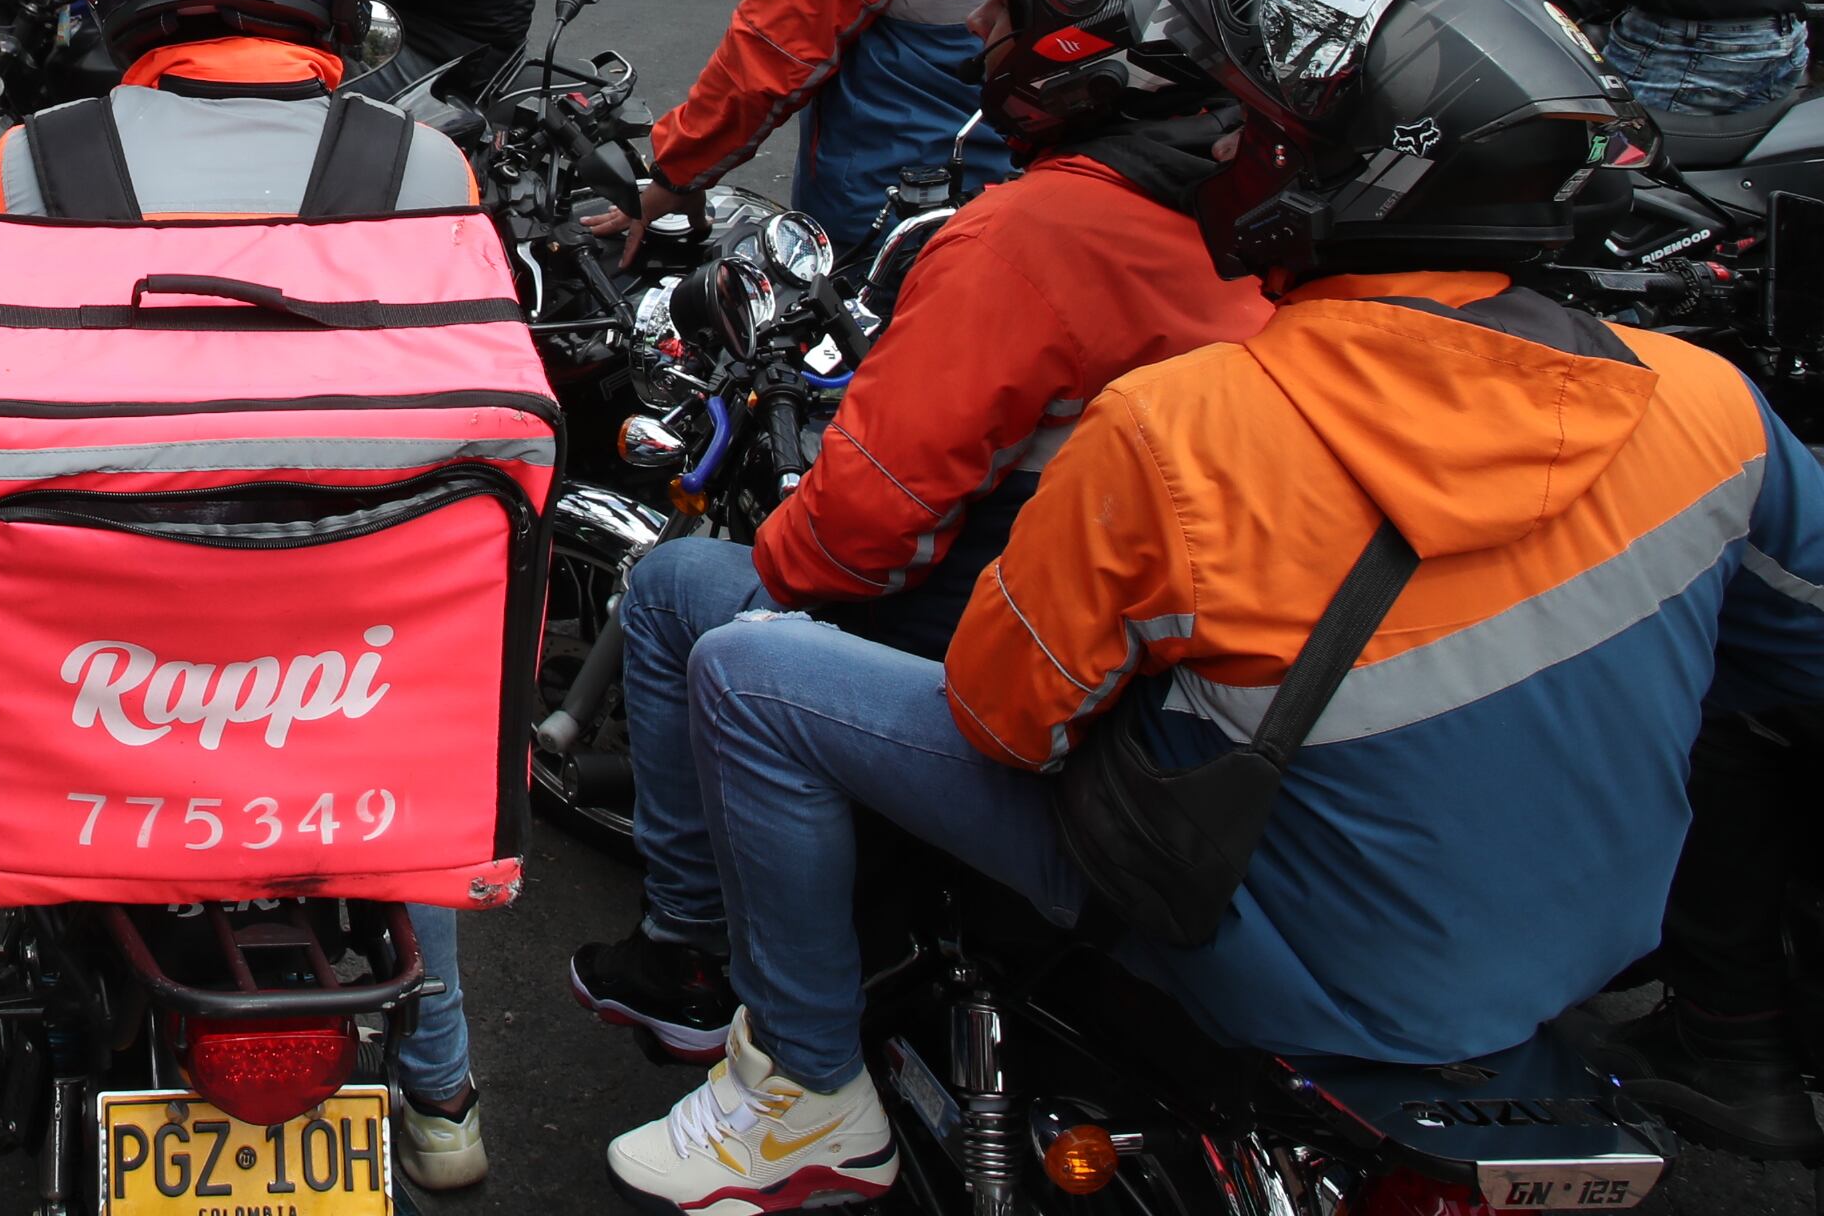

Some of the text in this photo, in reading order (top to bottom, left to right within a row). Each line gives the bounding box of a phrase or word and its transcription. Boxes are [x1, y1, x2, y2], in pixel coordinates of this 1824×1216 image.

[1641, 229, 1711, 265] RIDEMOOD
[60, 624, 395, 751] Rappi
[67, 788, 396, 850] 775349
[114, 1117, 380, 1199] PGZ 10H
[1505, 1181, 1630, 1205] GN 125
